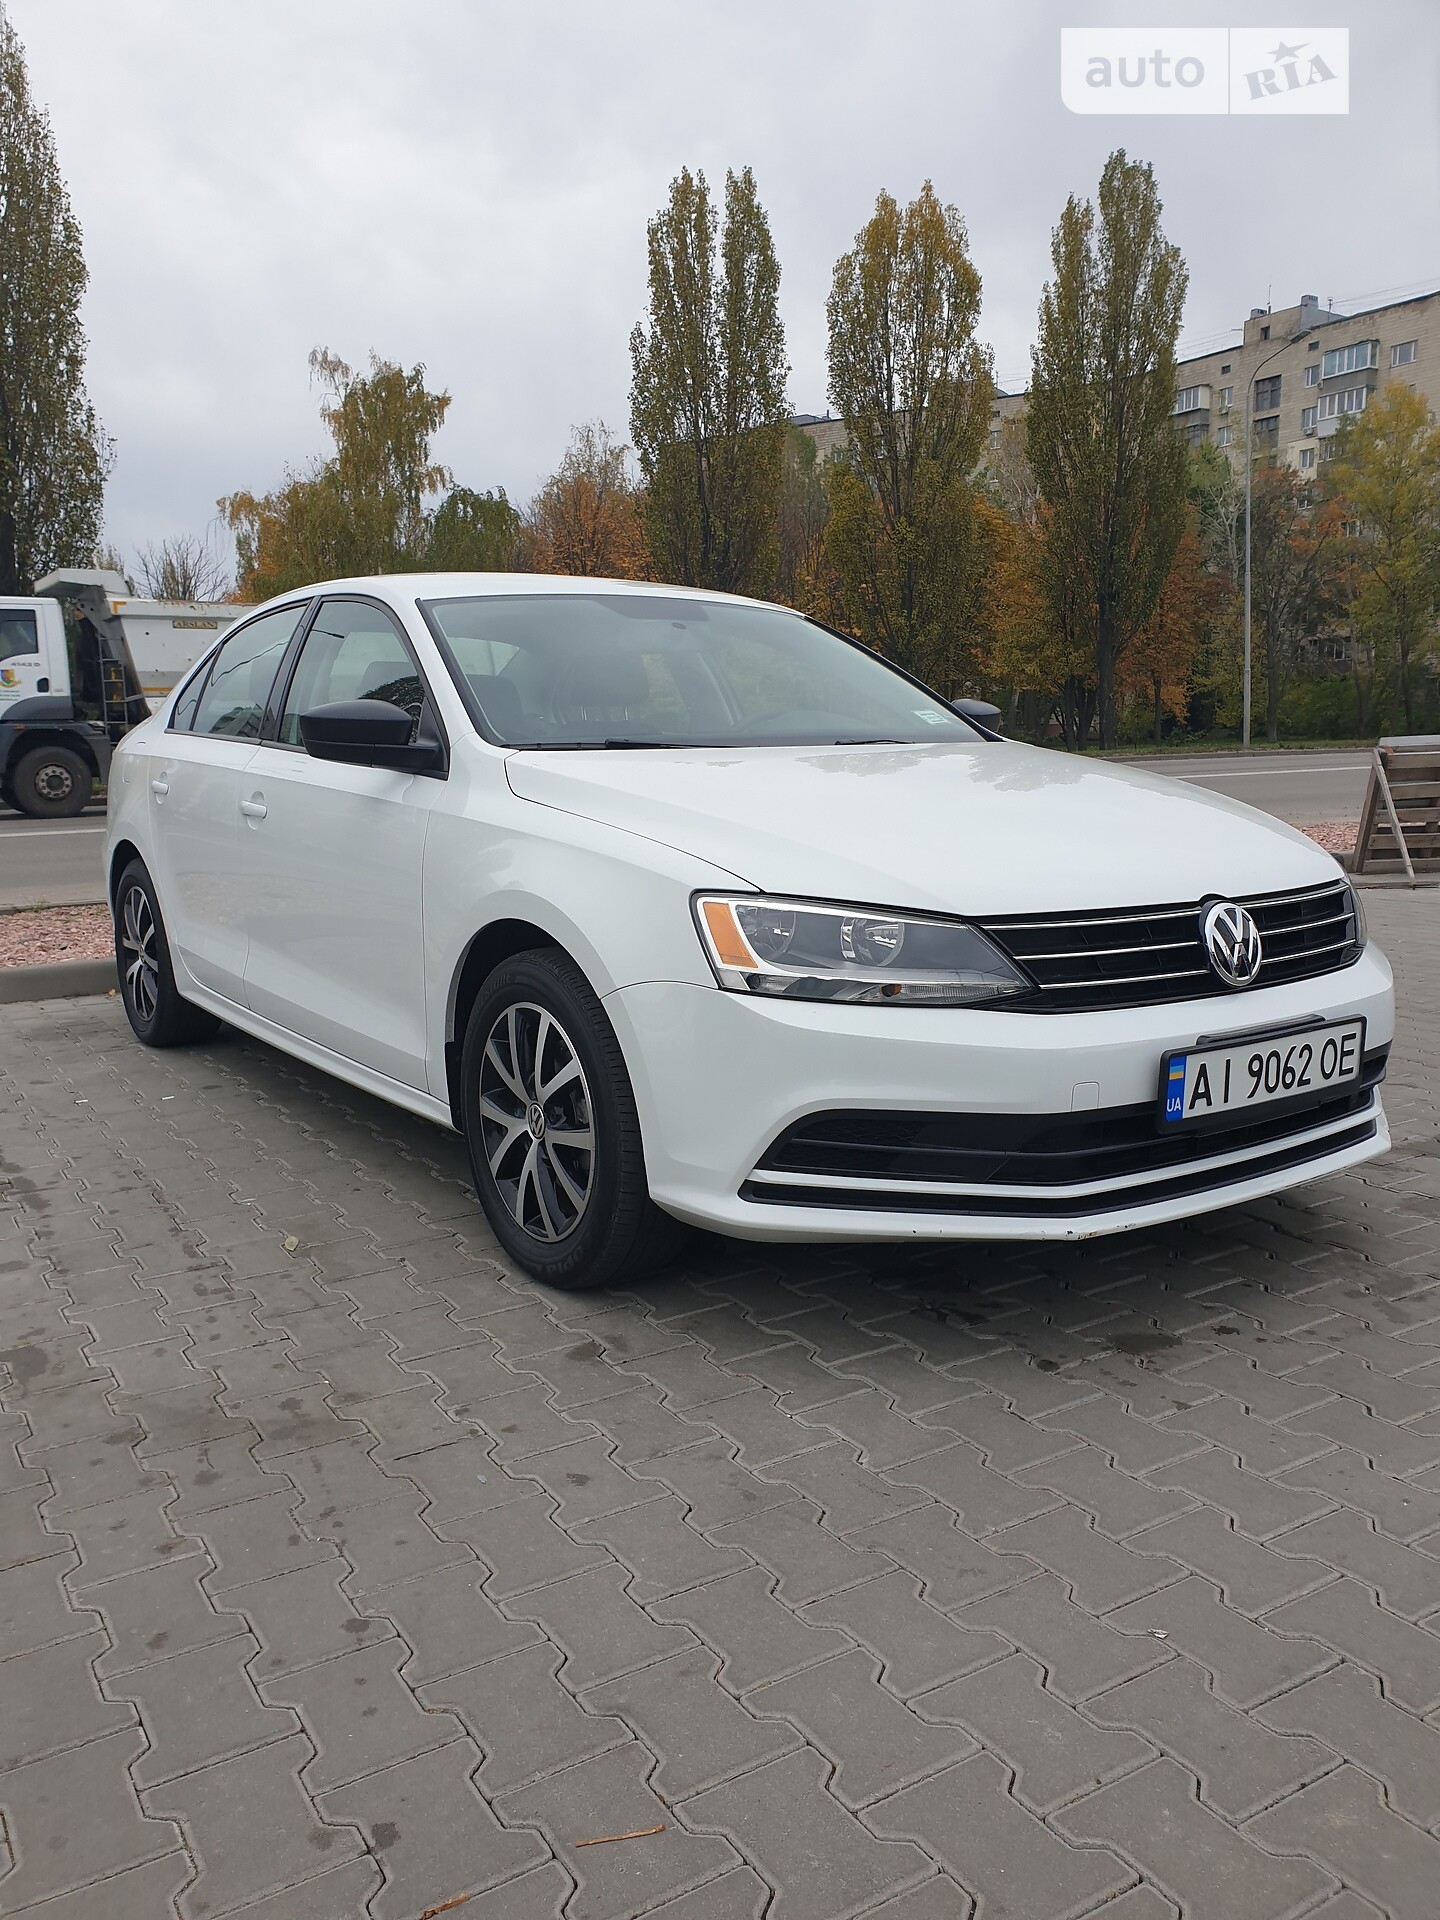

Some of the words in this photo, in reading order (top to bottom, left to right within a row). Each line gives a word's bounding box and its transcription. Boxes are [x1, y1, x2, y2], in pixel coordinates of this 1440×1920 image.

[1188, 1058, 1232, 1110] AI
[1247, 1043, 1313, 1100] 9062
[1320, 1032, 1357, 1080] OE
[1166, 1096, 1182, 1113] UA
